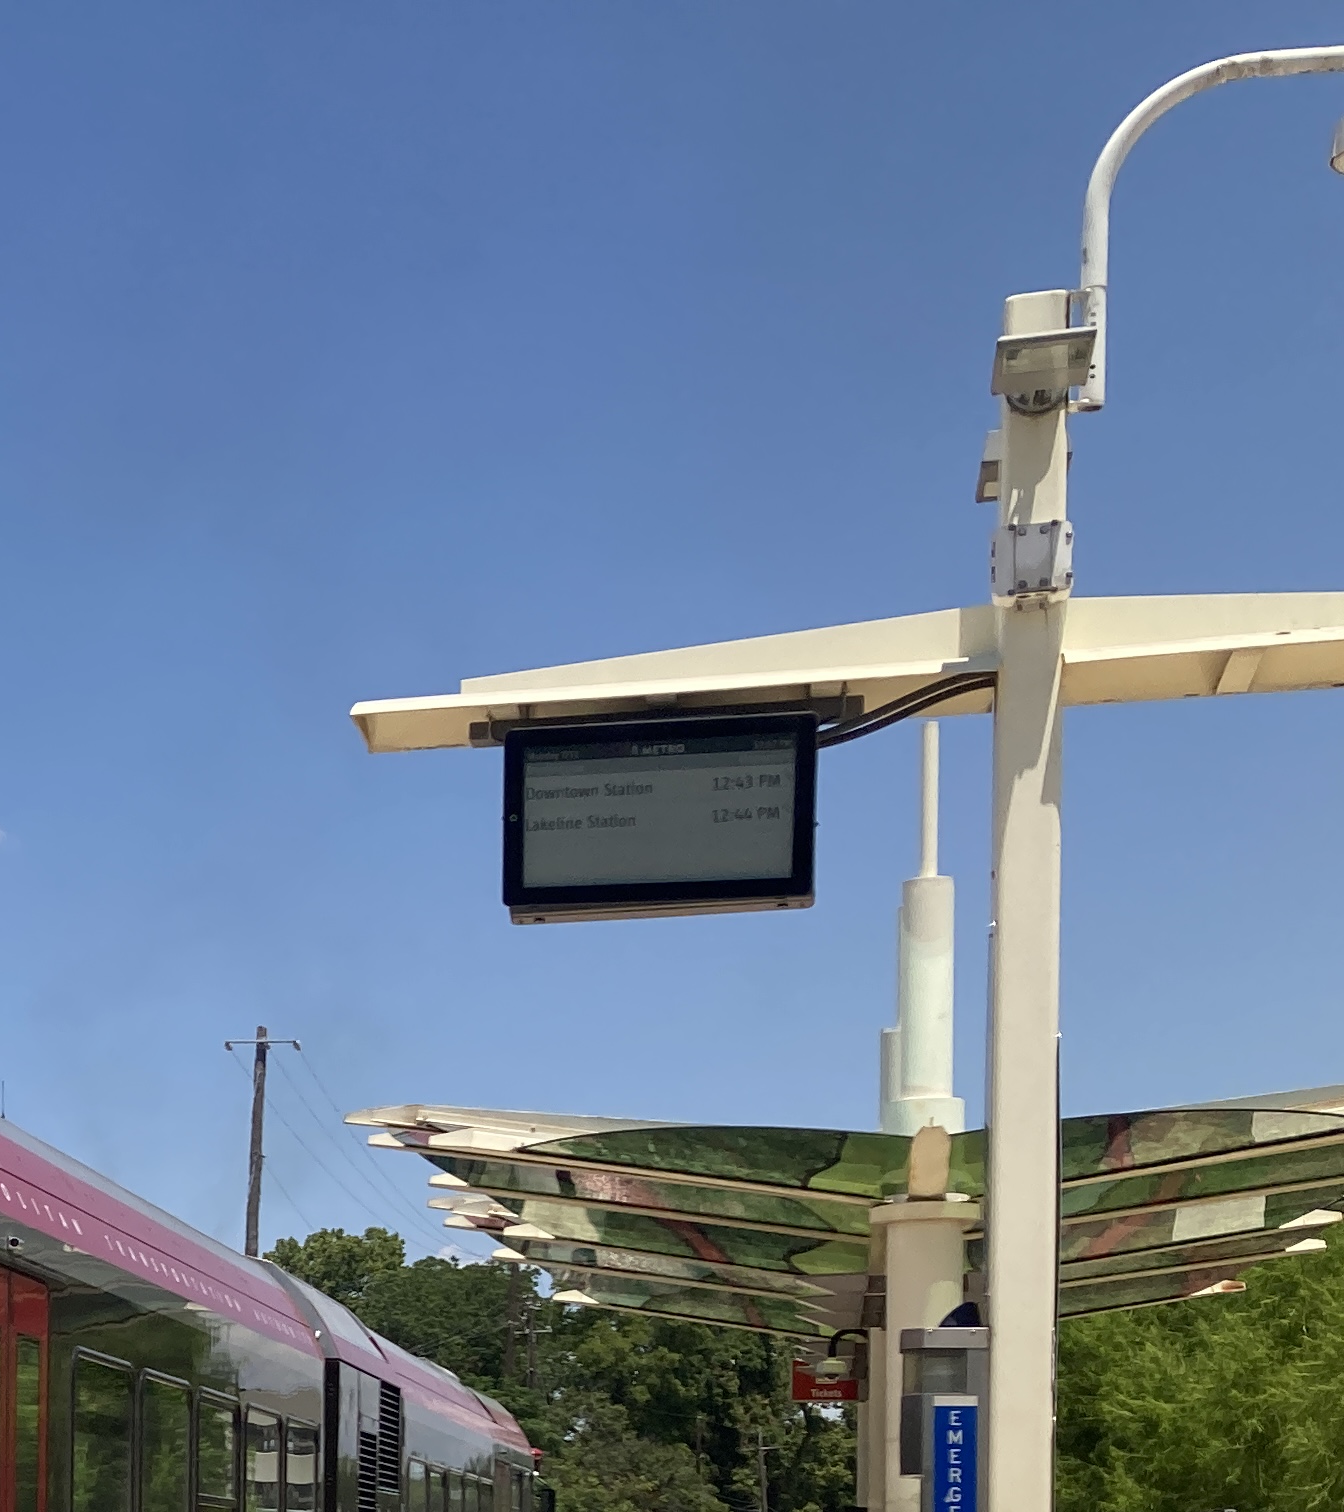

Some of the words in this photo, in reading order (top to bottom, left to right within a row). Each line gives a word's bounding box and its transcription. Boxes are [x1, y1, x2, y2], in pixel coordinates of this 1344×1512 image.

[525, 785, 599, 801] Downtown
[604, 783, 653, 798] Station
[759, 774, 781, 788] PM
[587, 814, 636, 829] Station
[757, 807, 780, 821] PM
[810, 1387, 843, 1398] Tickets
